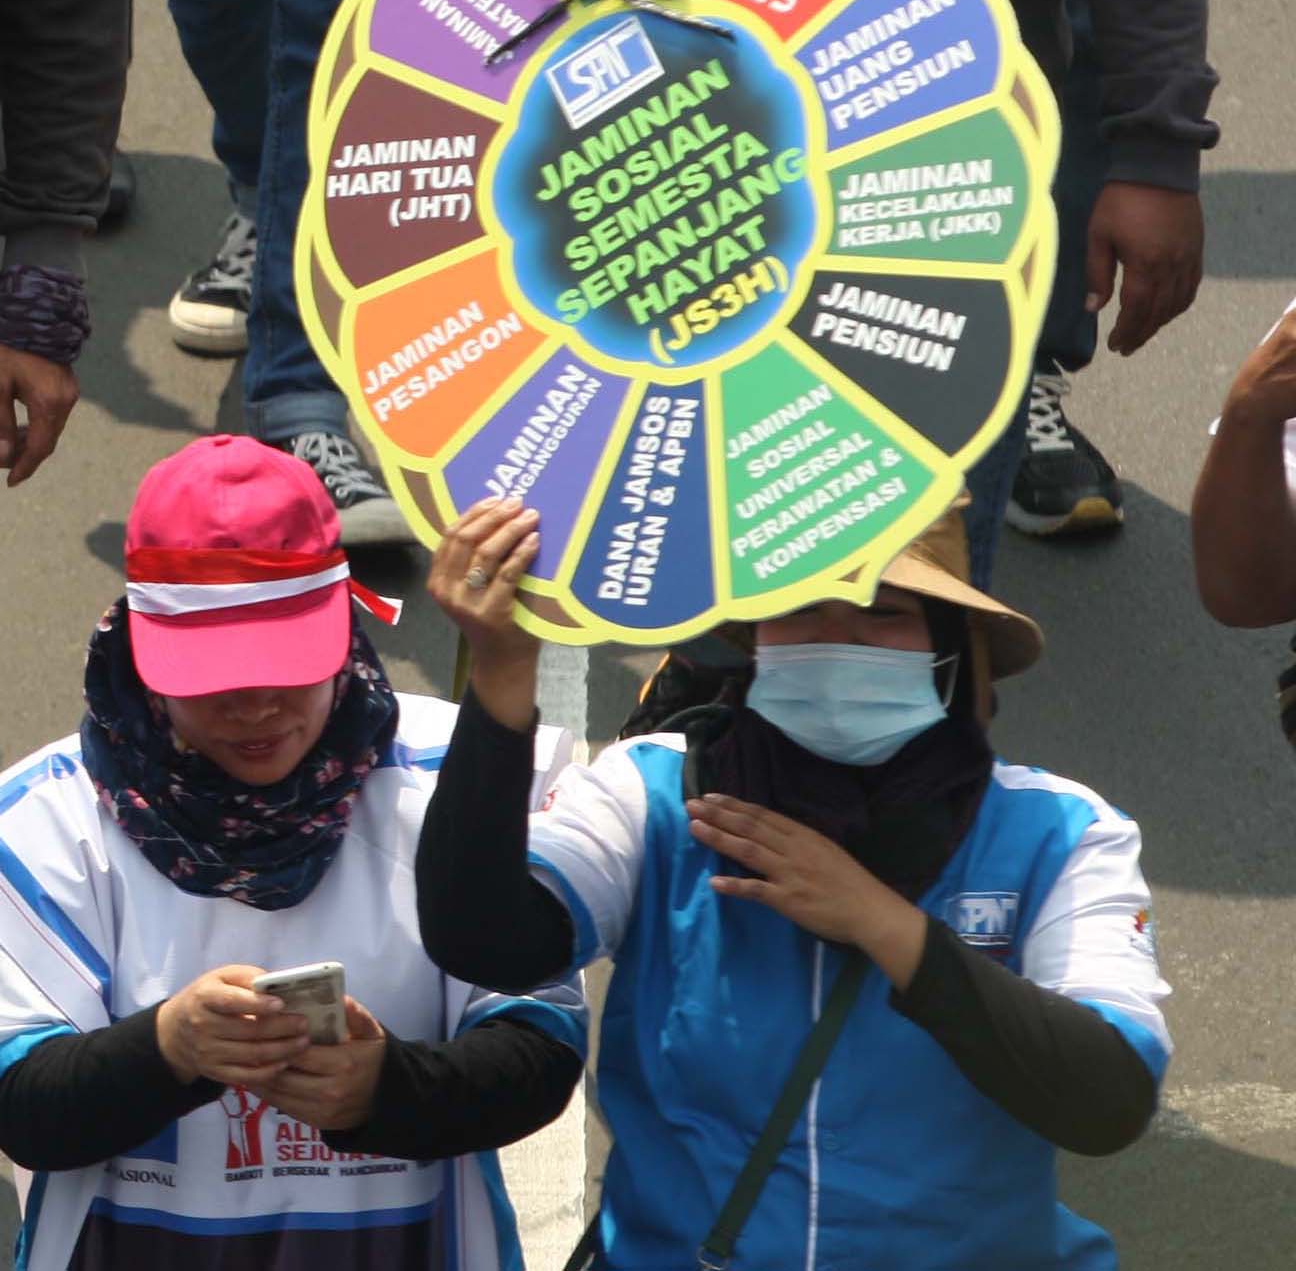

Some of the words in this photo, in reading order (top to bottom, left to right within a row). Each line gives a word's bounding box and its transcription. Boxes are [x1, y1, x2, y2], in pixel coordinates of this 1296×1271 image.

[818, 40, 915, 101] UANG
[829, 39, 977, 131] PENSIUN
[334, 135, 477, 169] JAMINAN
[536, 58, 731, 202] JAMINAN
[568, 113, 729, 223] SOSIAL
[327, 169, 402, 198] HARI
[410, 164, 475, 191] TUA
[389, 192, 473, 227] (JHT)
[564, 131, 770, 272] SEMESTA
[838, 159, 993, 200] JAMINAN
[838, 185, 1014, 225] KECELAKAAN
[556, 147, 808, 324] SEPANJANG
[626, 214, 768, 326] HAYAT
[838, 220, 926, 248] KERJA
[928, 211, 1003, 241] (JKK)
[363, 301, 485, 395] JAMINAN
[649, 255, 789, 364] (JS3H)
[811, 312, 957, 372] PENSIUN
[817, 282, 967, 340] JAMINAN
[372, 312, 524, 422] PESANGON
[485, 364, 589, 501] JAMINAN
[510, 376, 603, 499] NGANGGURAN
[657, 397, 701, 478] APBN
[725, 384, 834, 459] JAMINAN
[746, 419, 838, 479] SOSIAL
[597, 520, 640, 601] DANA
[621, 395, 673, 514] JAMSOS
[650, 486, 677, 507] &
[731, 459, 880, 559] PERAWATAN
[880, 446, 904, 469] &
[736, 432, 874, 520] UNIVERSAL
[622, 515, 670, 606] IURAN
[752, 477, 908, 580] KONPENSASI
[108, 1166, 178, 1189] ASIONAL
